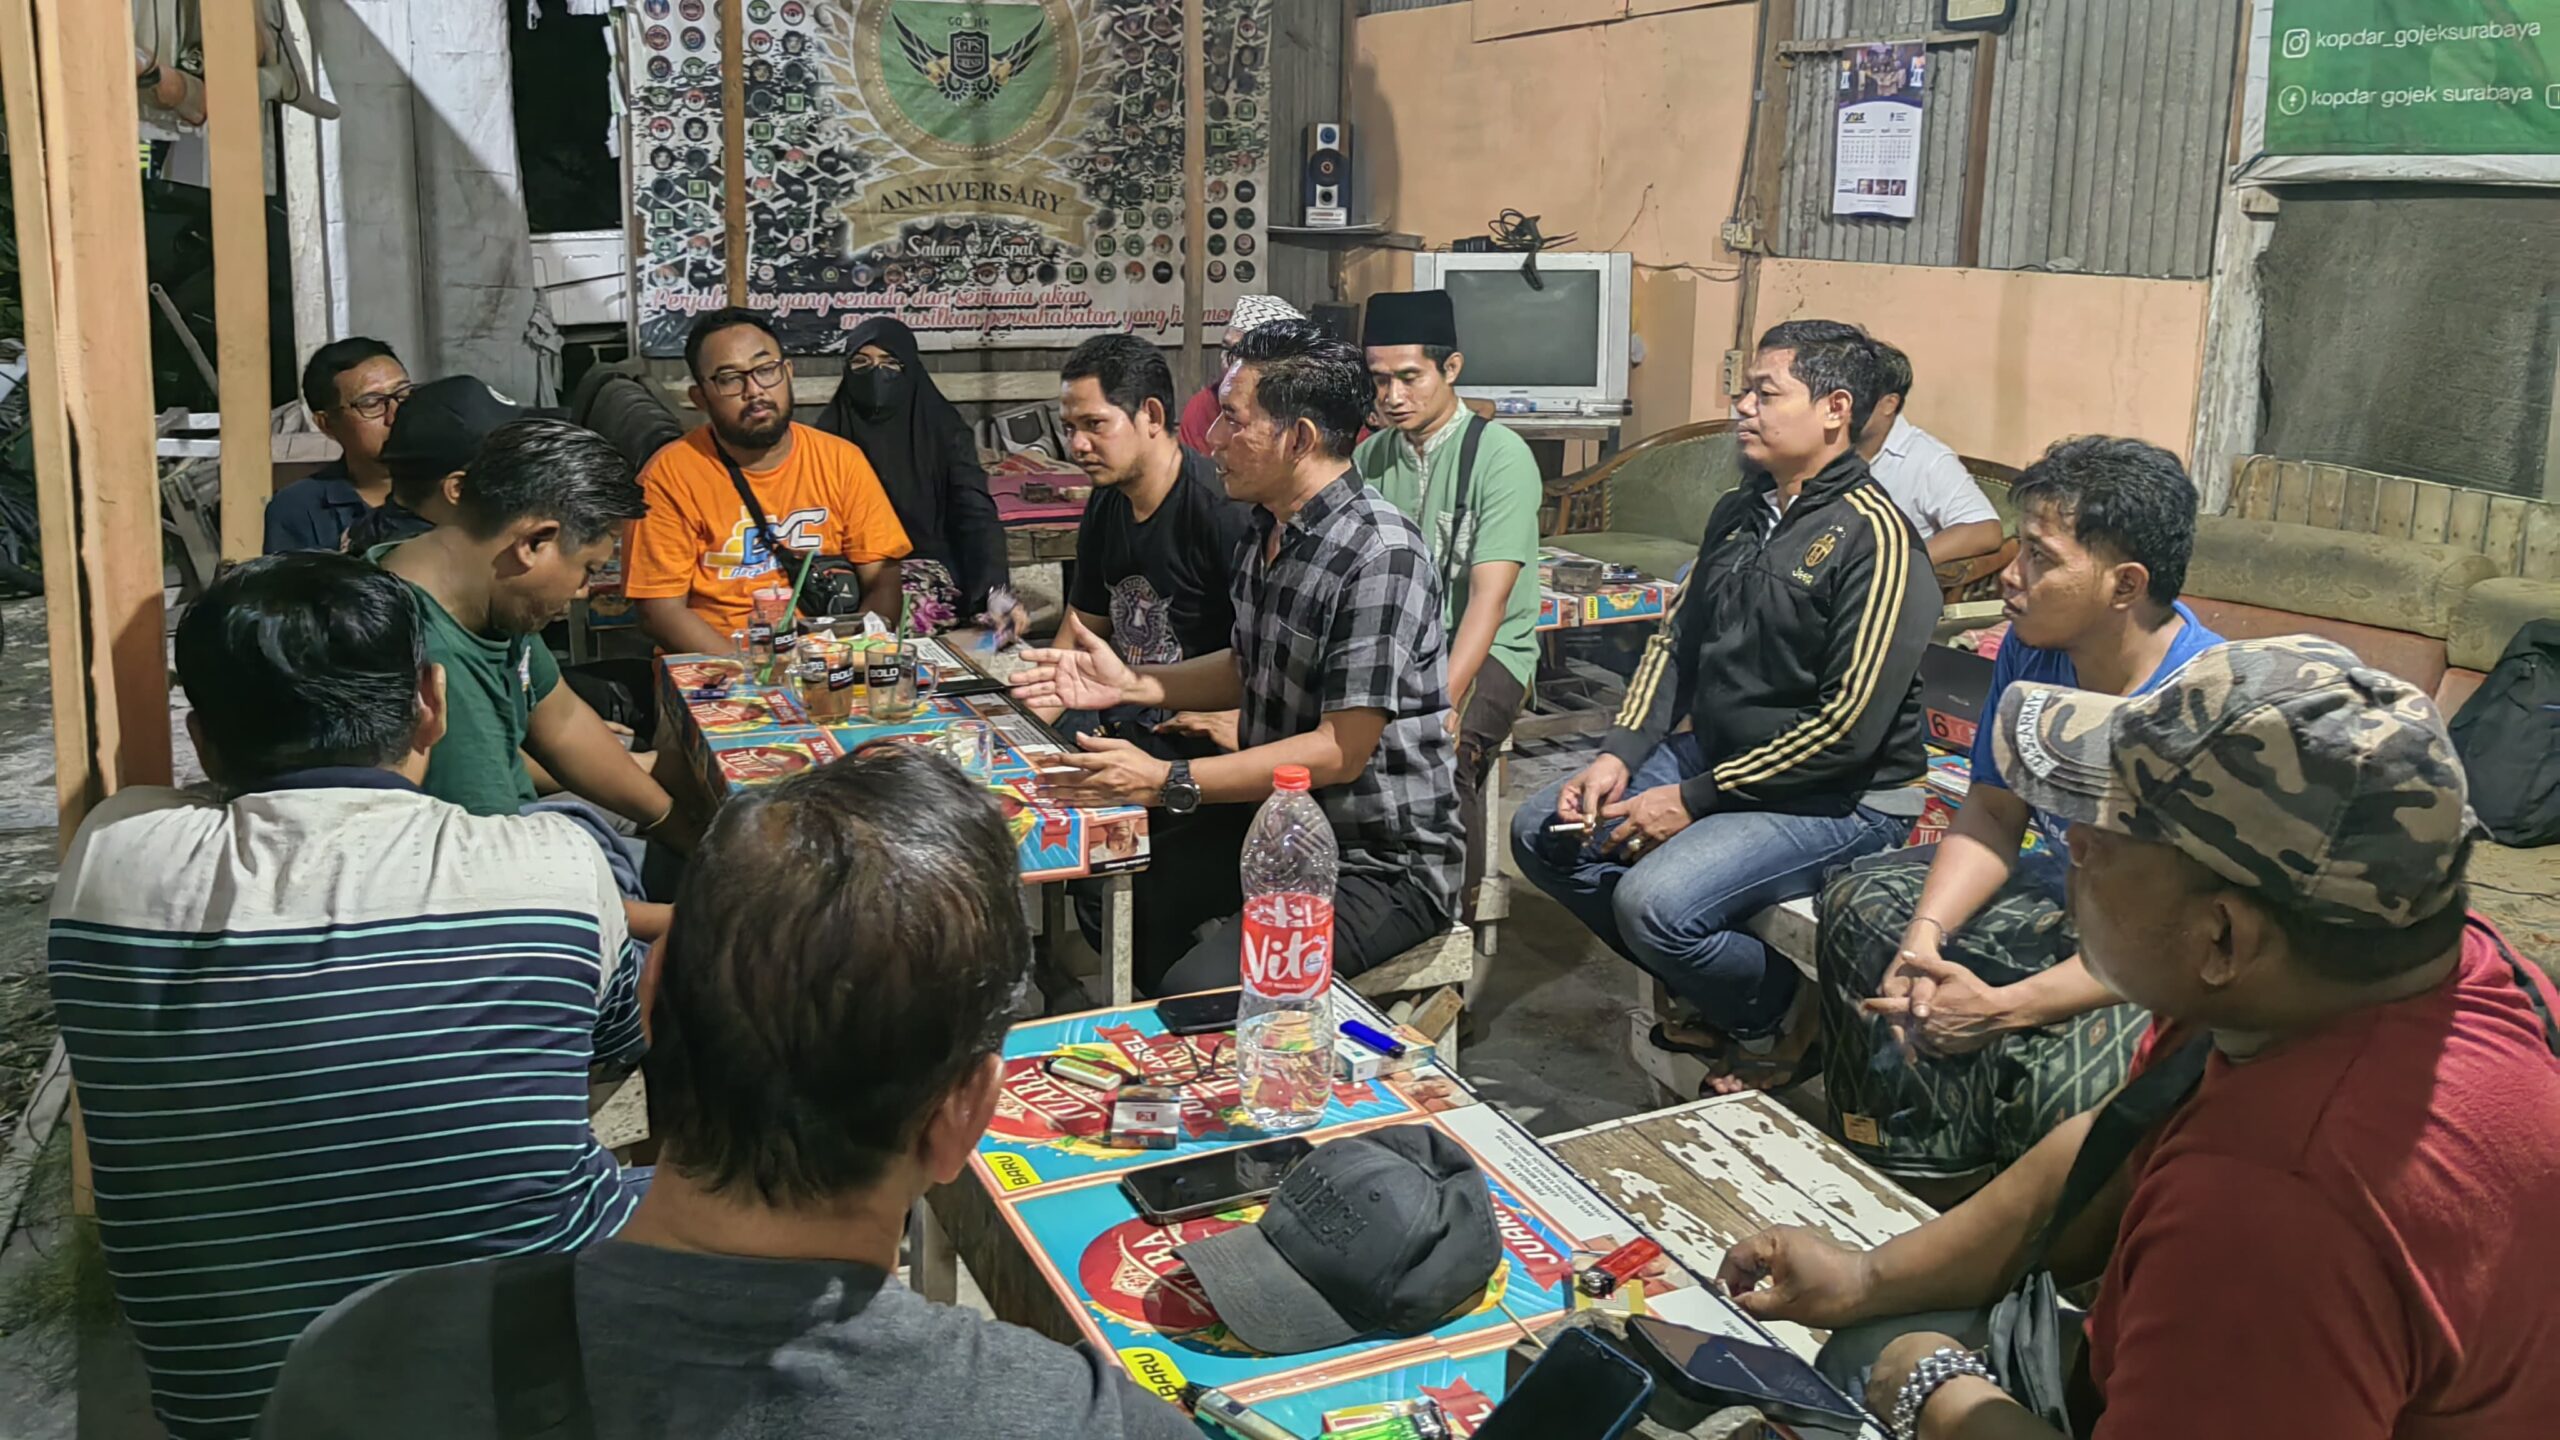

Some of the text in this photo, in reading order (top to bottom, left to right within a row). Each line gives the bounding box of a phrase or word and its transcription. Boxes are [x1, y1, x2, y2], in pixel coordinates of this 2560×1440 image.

[2315, 22, 2541, 50] kopdar_gojeksurabaya
[2311, 85, 2532, 108] kopdar gojek surabaya
[880, 181, 1065, 213] ANNIVERSARY
[907, 235, 1033, 260] Salam Aspal
[654, 284, 1089, 317] Perjalan yang senada dan seirama akan
[981, 304, 1117, 333] persahabatan
[1122, 310, 1167, 334] yang
[1006, 1067, 1100, 1121] JUARA
[993, 1155, 1029, 1186] BARU
[1134, 1352, 1180, 1400] BARU
